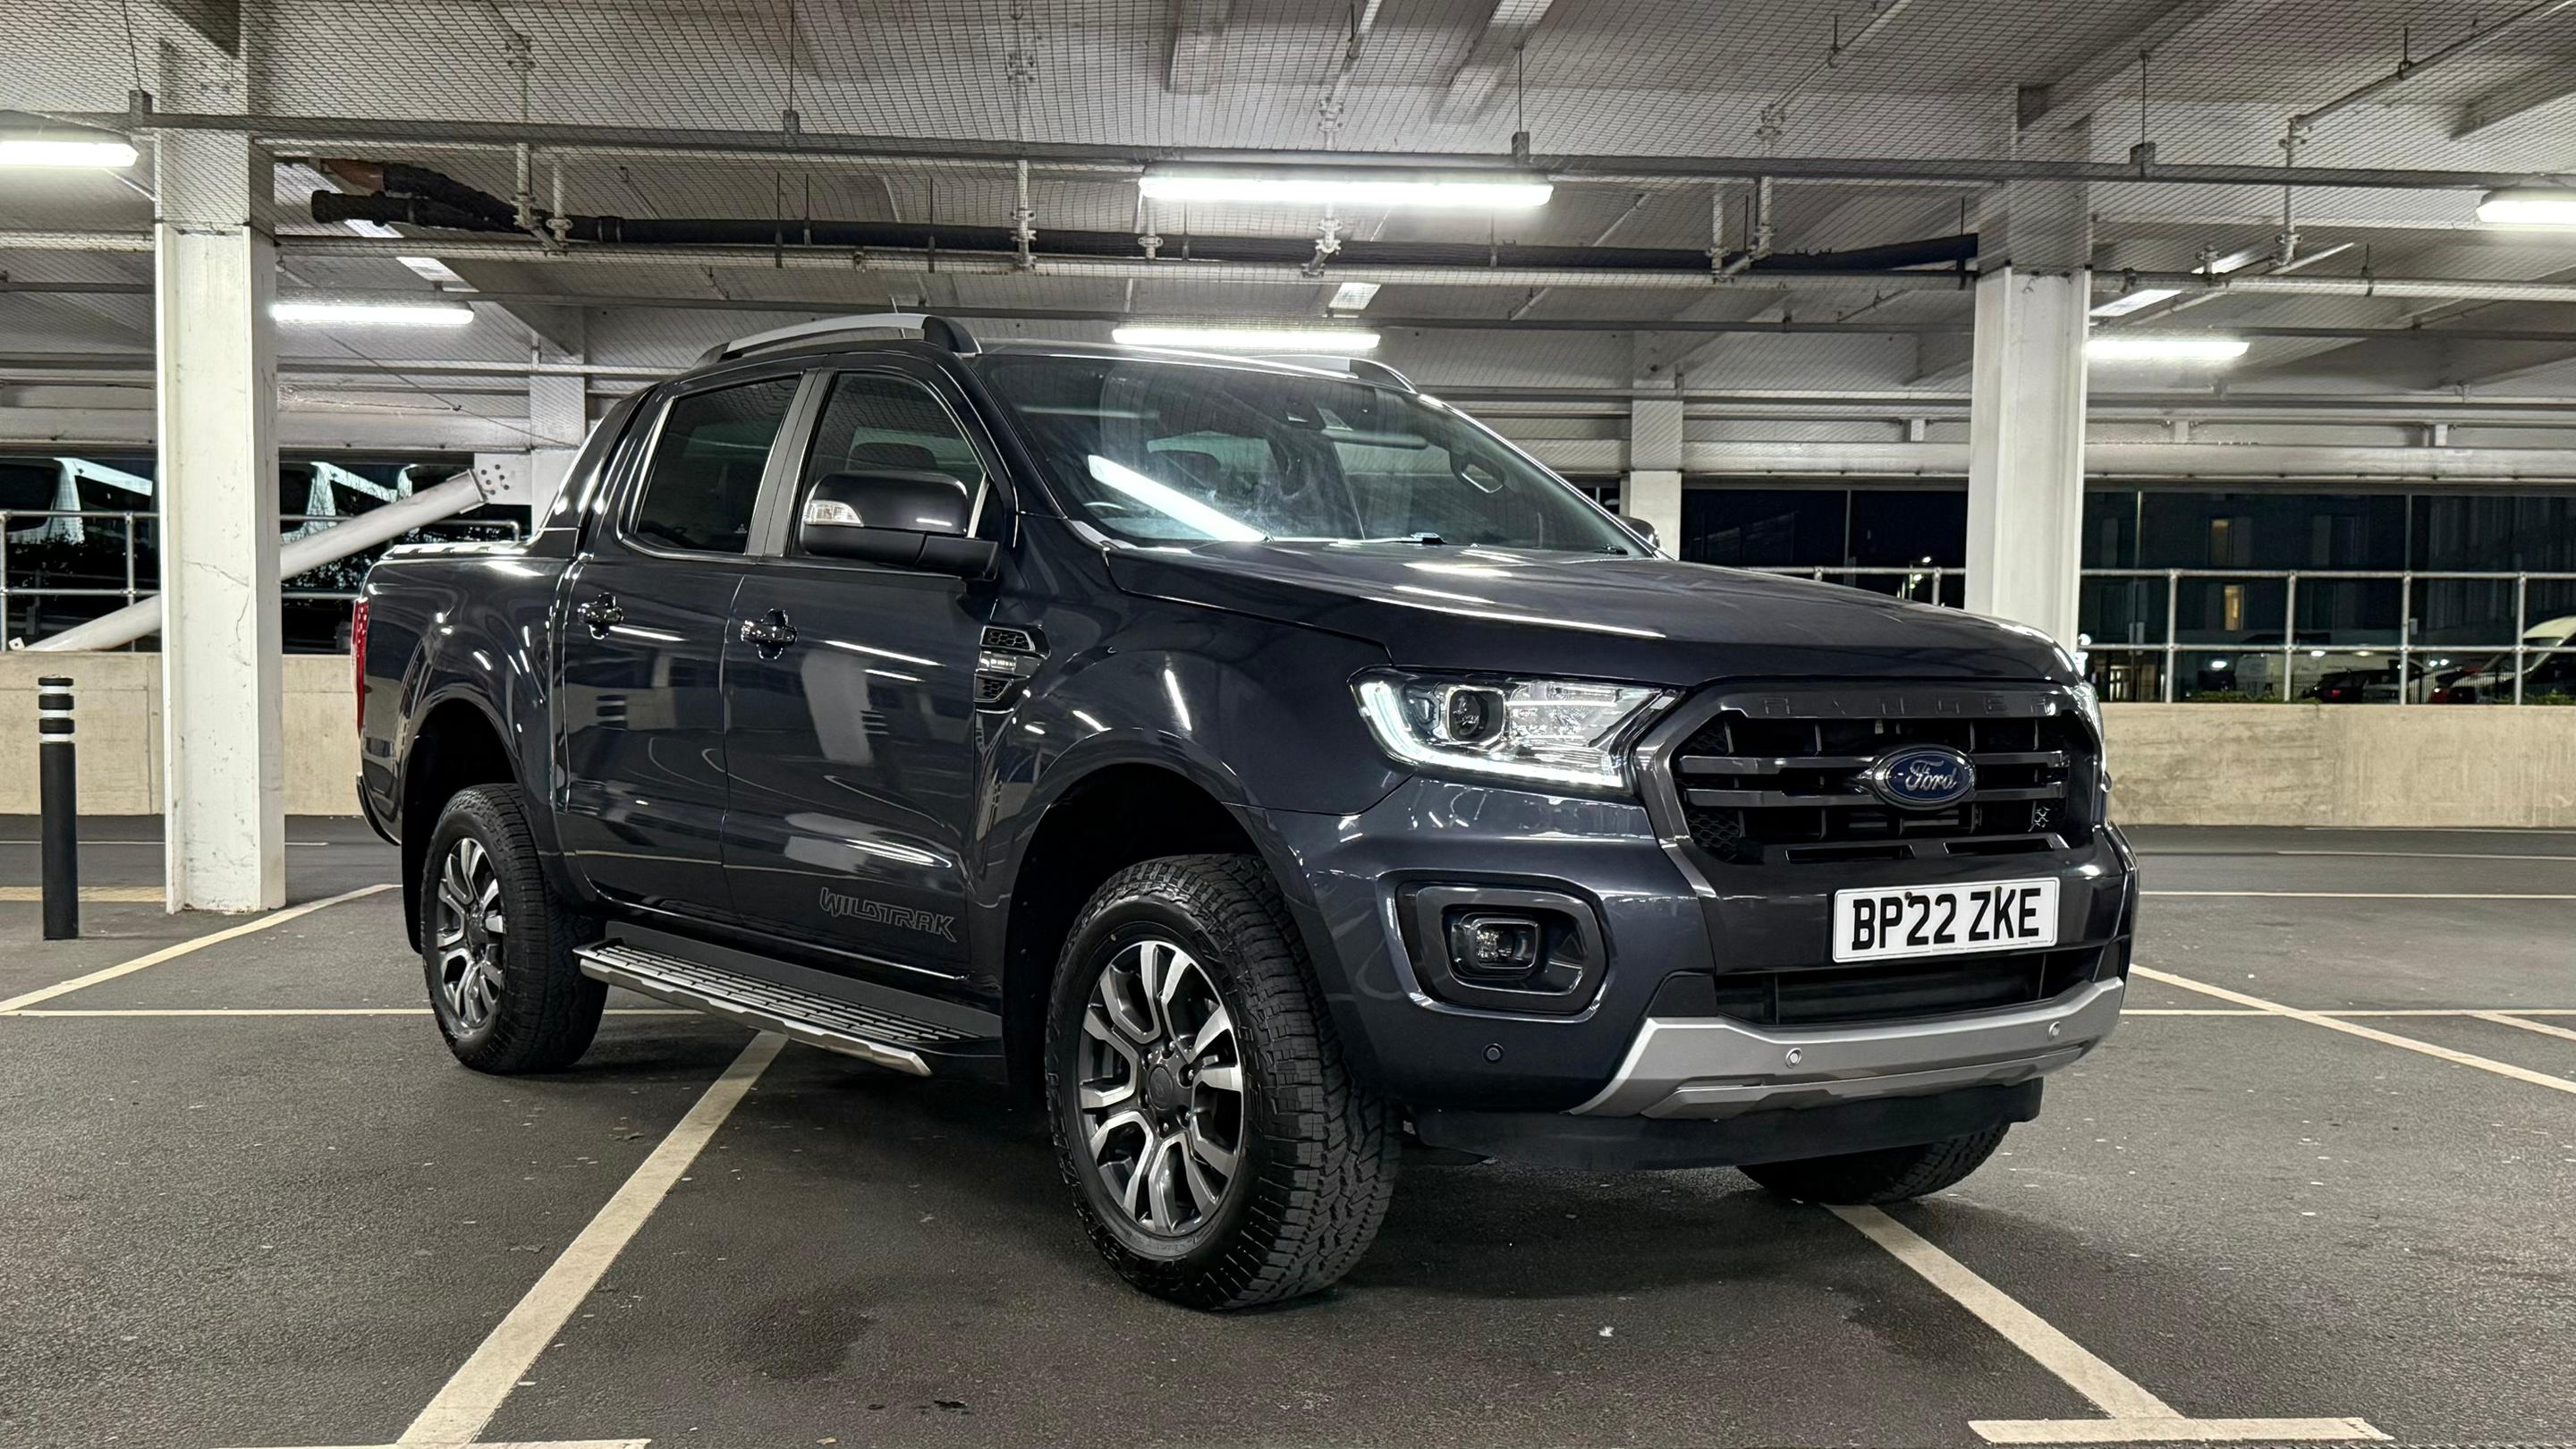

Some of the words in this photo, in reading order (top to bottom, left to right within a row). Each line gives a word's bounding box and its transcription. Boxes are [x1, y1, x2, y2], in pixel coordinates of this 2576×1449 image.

[1905, 760, 1957, 791] Ford
[819, 887, 957, 943] WILDTRAK
[1852, 894, 1957, 951] BP22
[1968, 887, 2041, 942] ZKE
